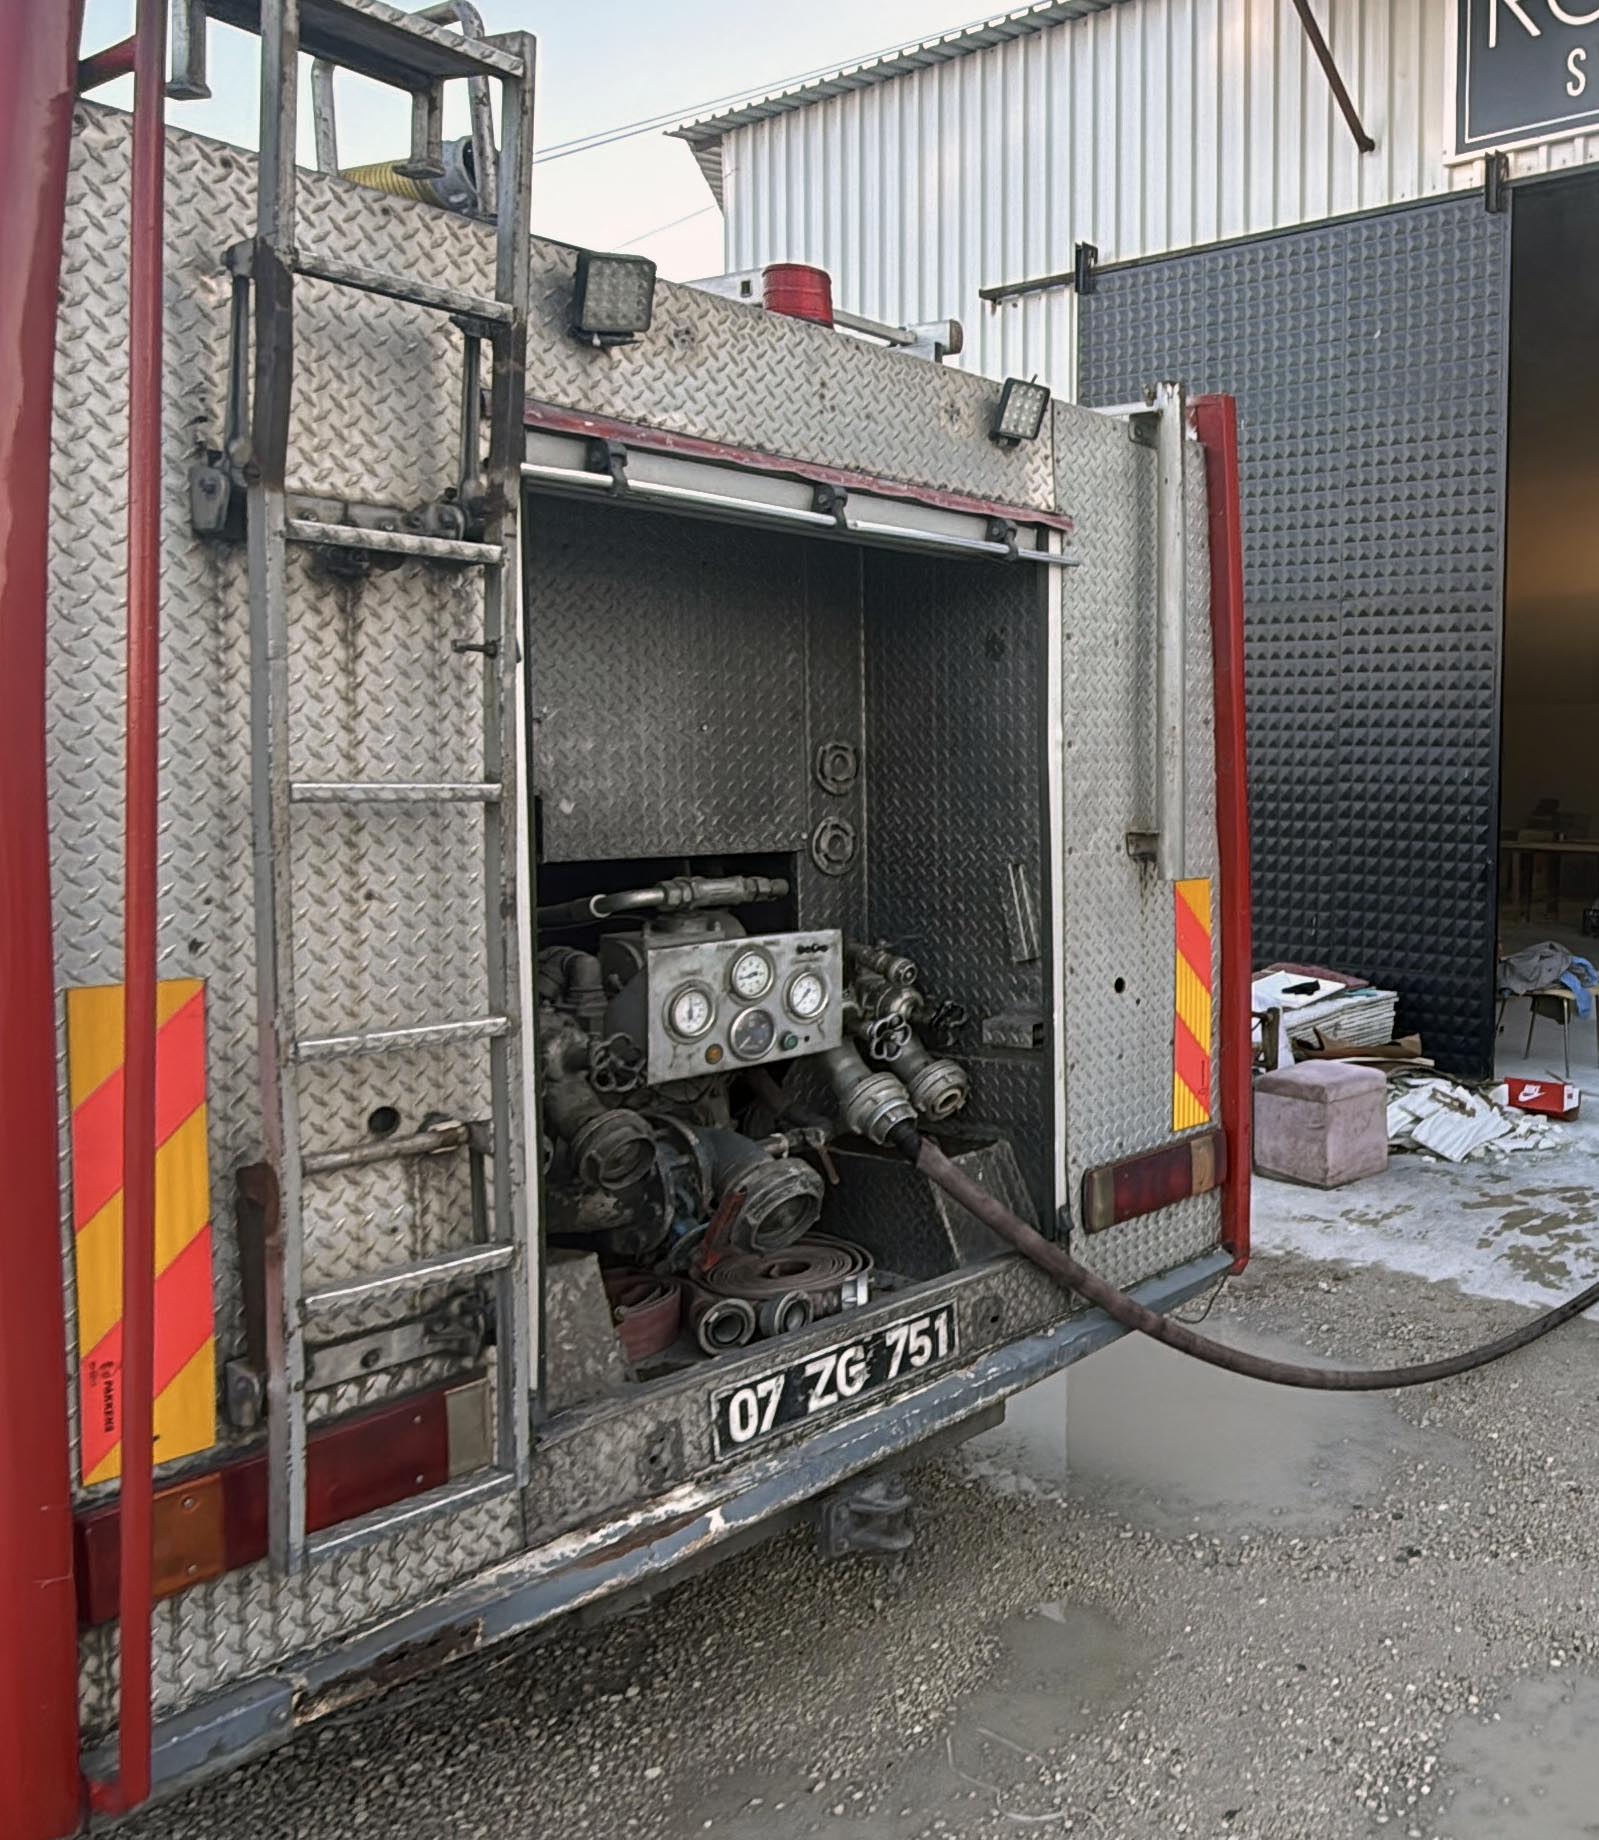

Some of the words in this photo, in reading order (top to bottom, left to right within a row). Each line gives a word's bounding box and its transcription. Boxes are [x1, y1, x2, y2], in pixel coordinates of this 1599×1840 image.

[728, 1373, 786, 1443] 07
[804, 1344, 871, 1414] ZG
[885, 1310, 949, 1380] 751
